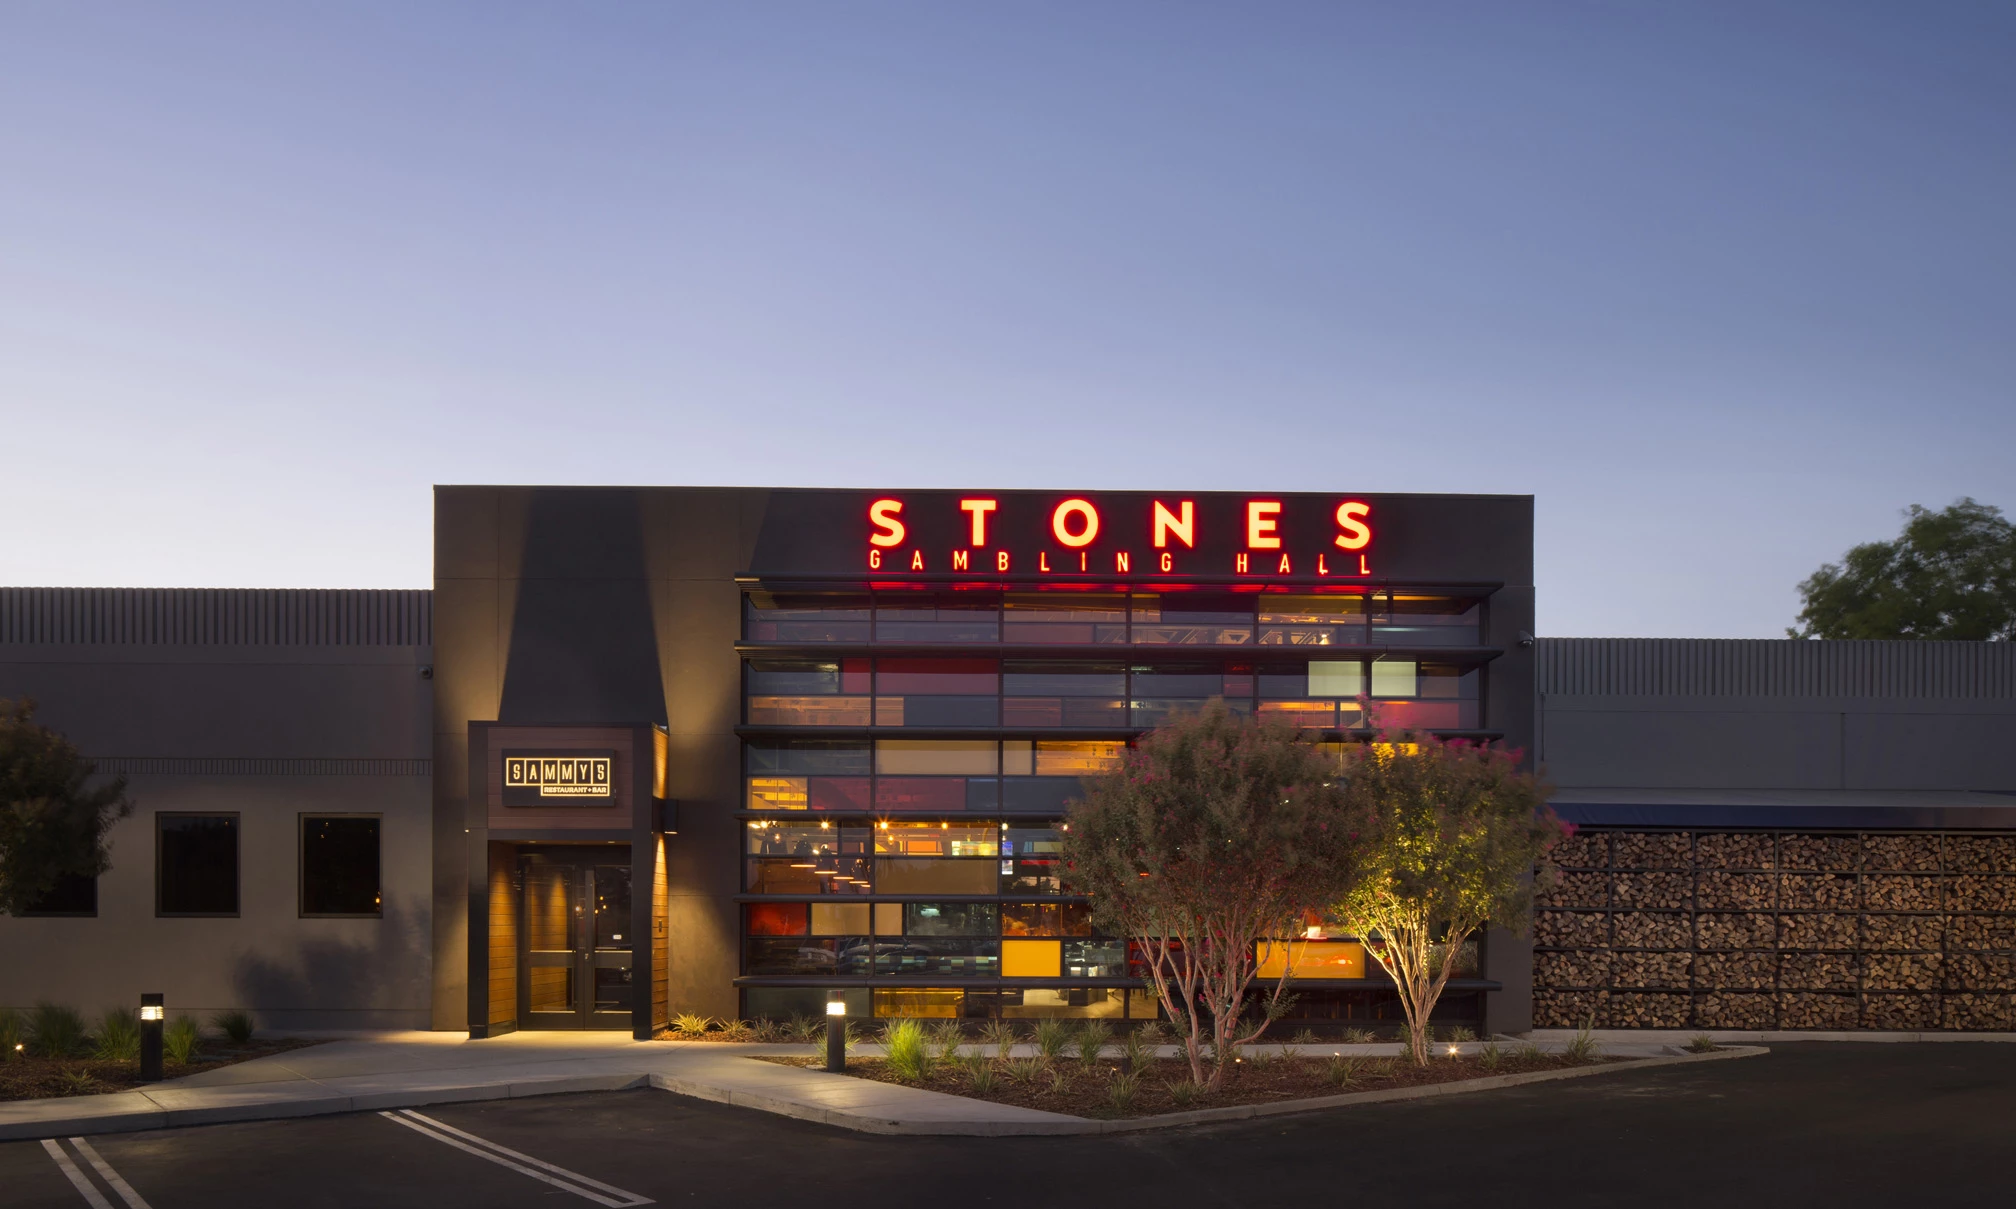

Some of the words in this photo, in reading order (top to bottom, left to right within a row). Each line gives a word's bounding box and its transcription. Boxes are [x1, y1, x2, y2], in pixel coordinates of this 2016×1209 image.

[869, 498, 1371, 549] STONES
[869, 549, 1172, 573] GAMBLING
[1236, 553, 1371, 575] HALL
